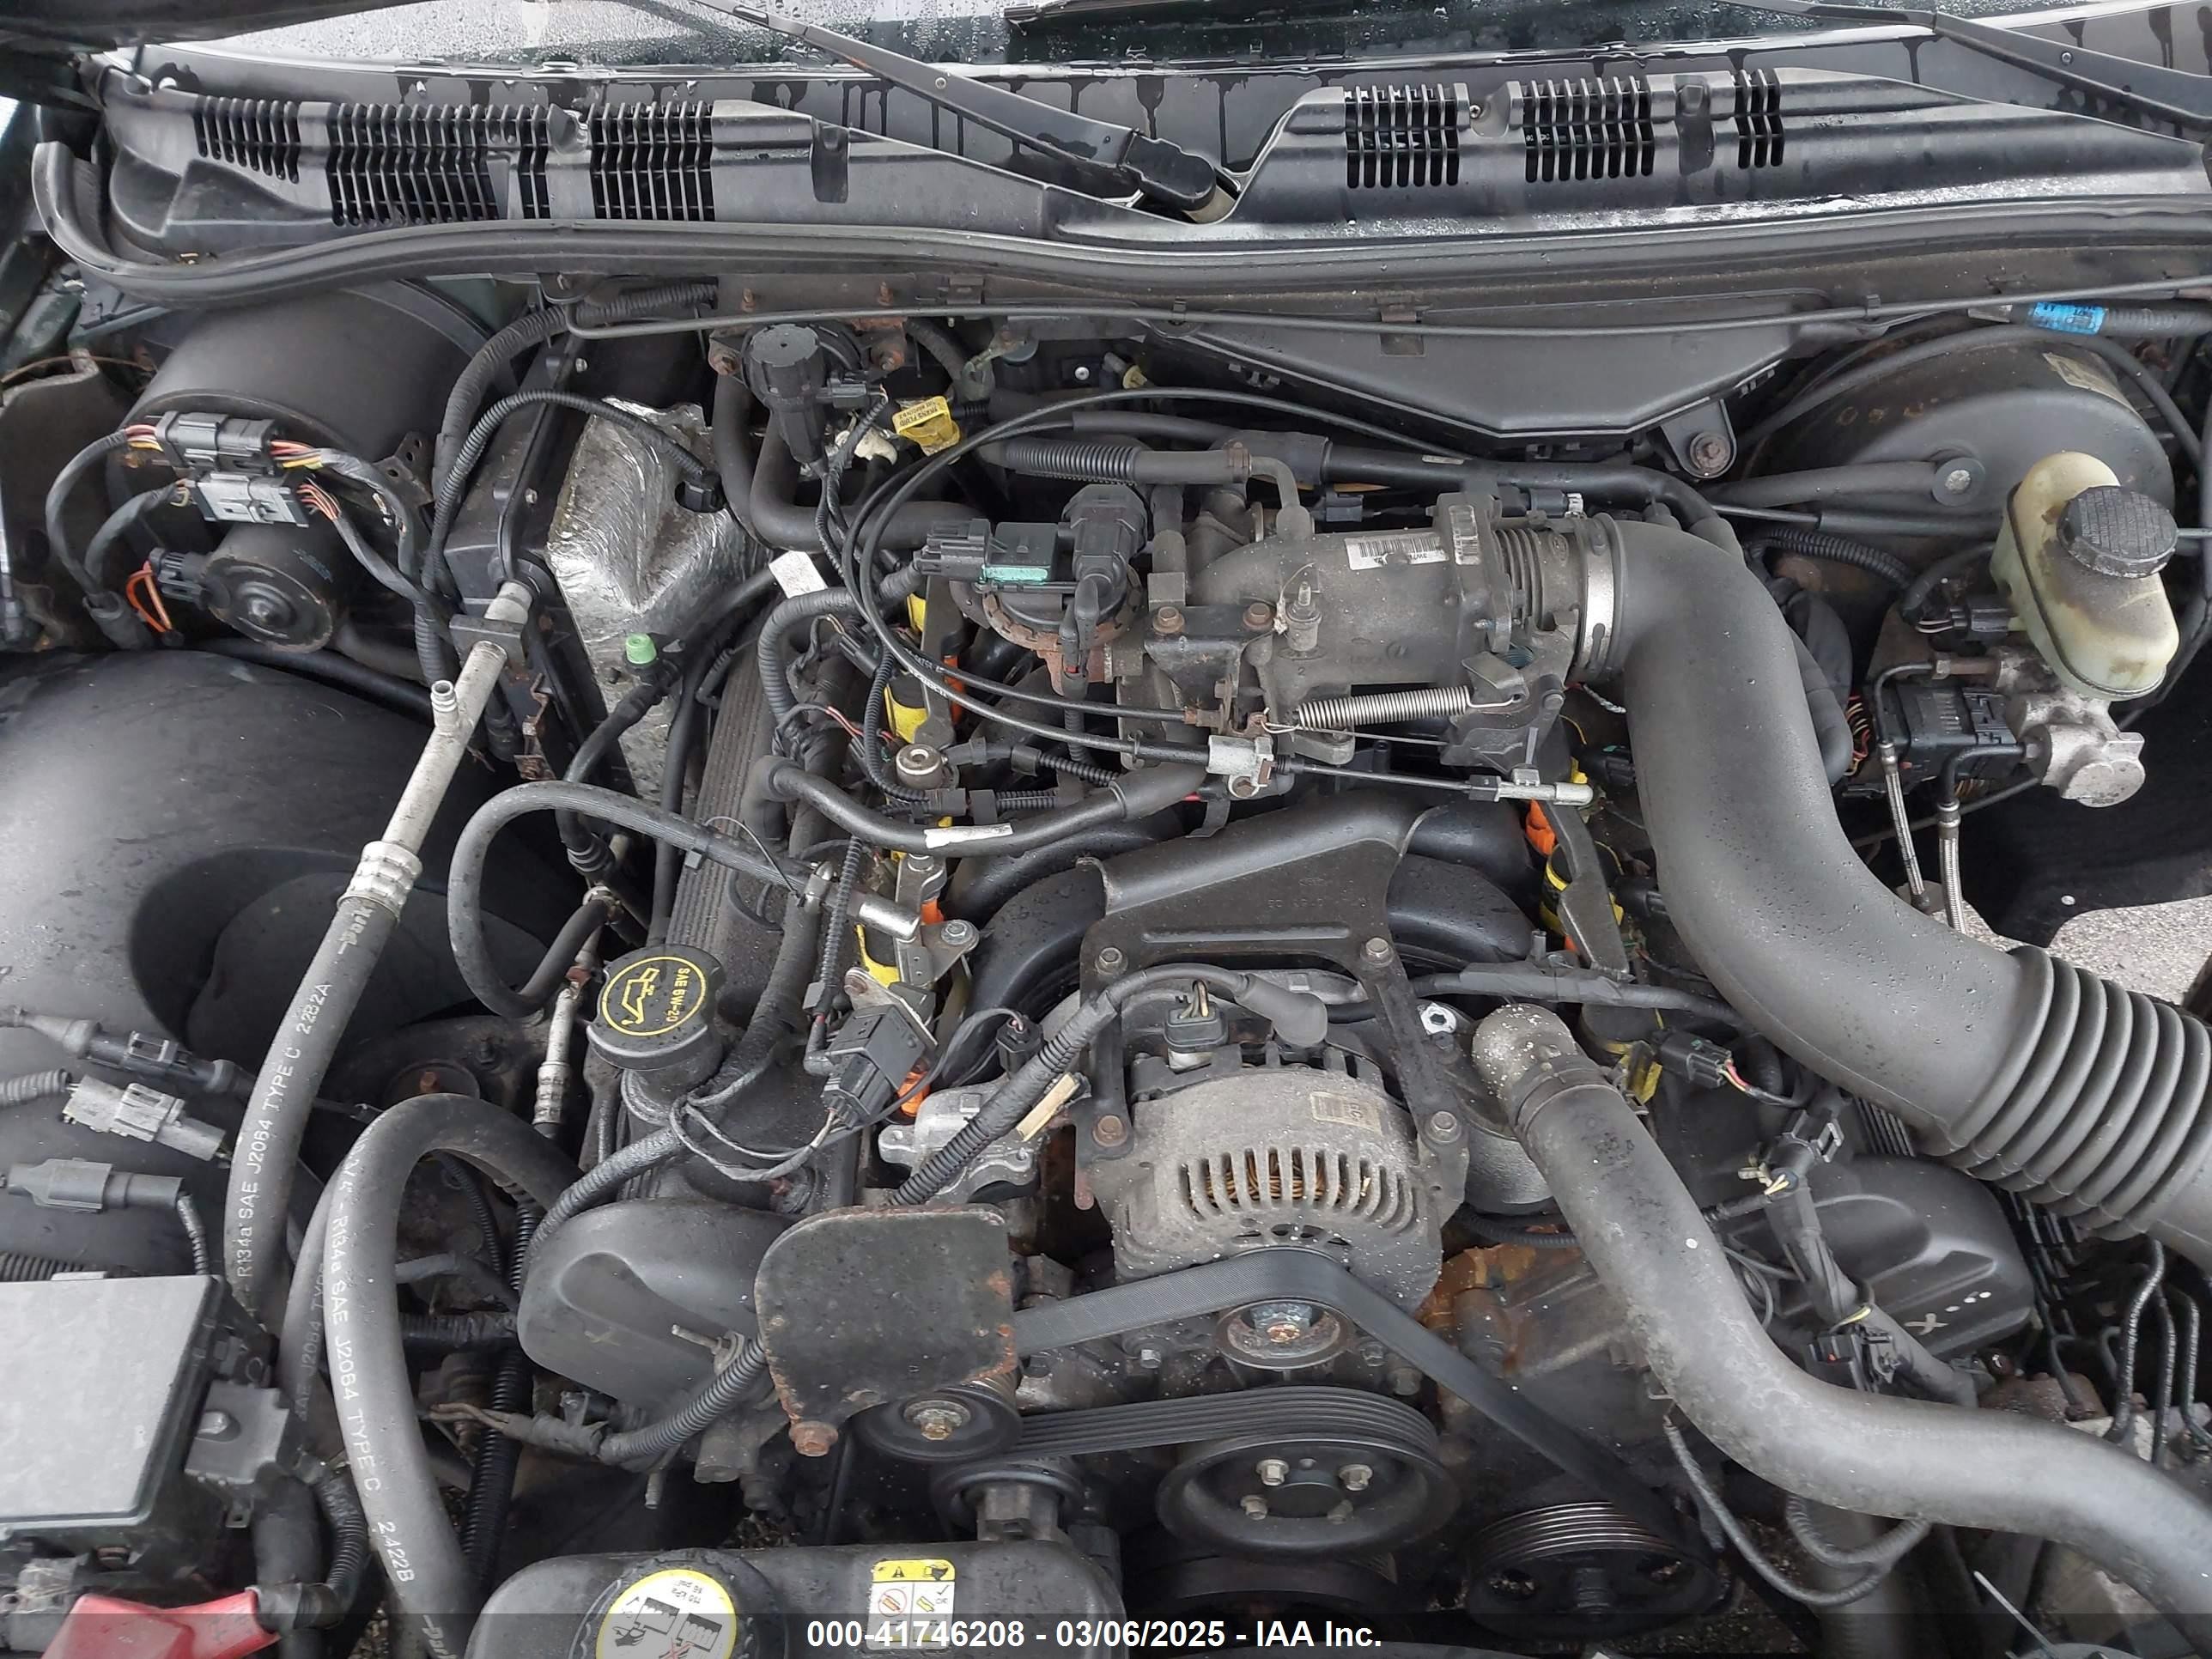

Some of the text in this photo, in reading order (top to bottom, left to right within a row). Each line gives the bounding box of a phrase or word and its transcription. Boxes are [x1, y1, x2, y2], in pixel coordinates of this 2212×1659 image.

[900, 404, 938, 427] TRANS FLUID
[674, 968, 690, 988] SAE
[284, 1046, 301, 1059] C
[262, 1063, 294, 1111] TYPE
[246, 1119, 273, 1175] J2064
[239, 1181, 259, 1219] SAE
[237, 1224, 253, 1278] R134a
[331, 1214, 350, 1273] R134a
[330, 1279, 349, 1326] SAE
[335, 1335, 359, 1401] J2064
[346, 1408, 376, 1470] TYPE
[363, 1477, 381, 1492] C
